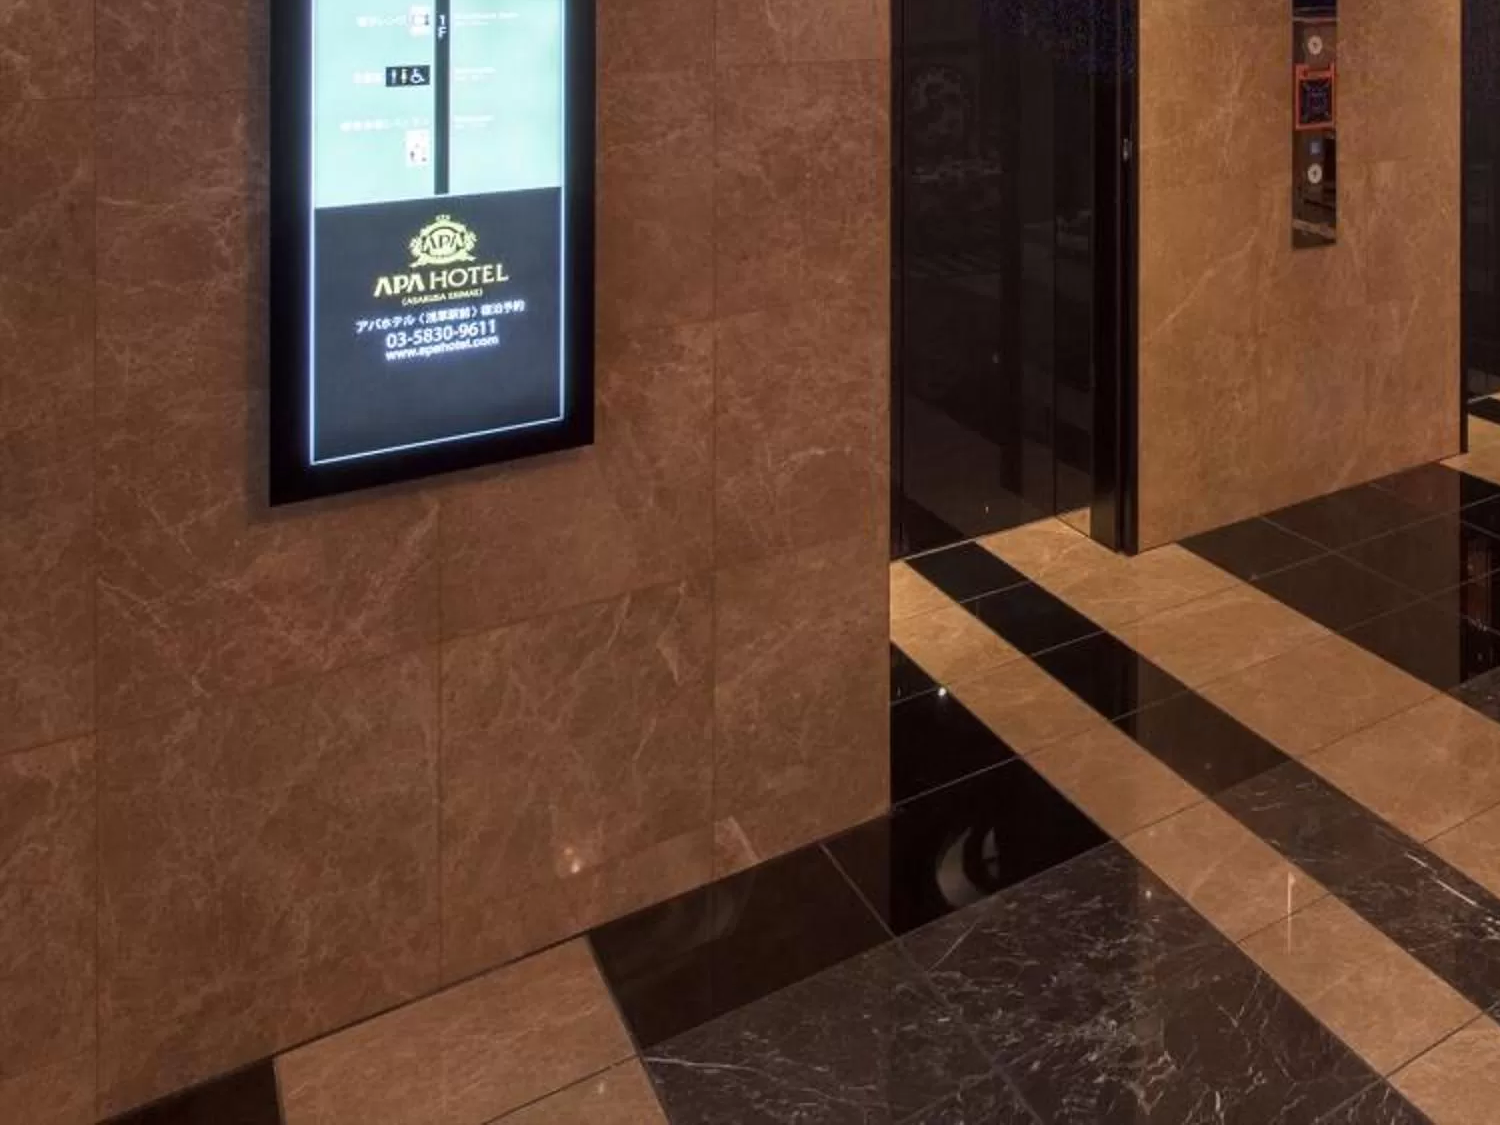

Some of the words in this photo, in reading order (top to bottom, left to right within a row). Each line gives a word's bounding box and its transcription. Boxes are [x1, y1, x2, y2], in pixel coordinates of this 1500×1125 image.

[422, 233, 464, 250] APA
[373, 272, 424, 297] APA
[429, 263, 510, 290] HOTEL
[386, 319, 497, 349] 03-5830-9611
